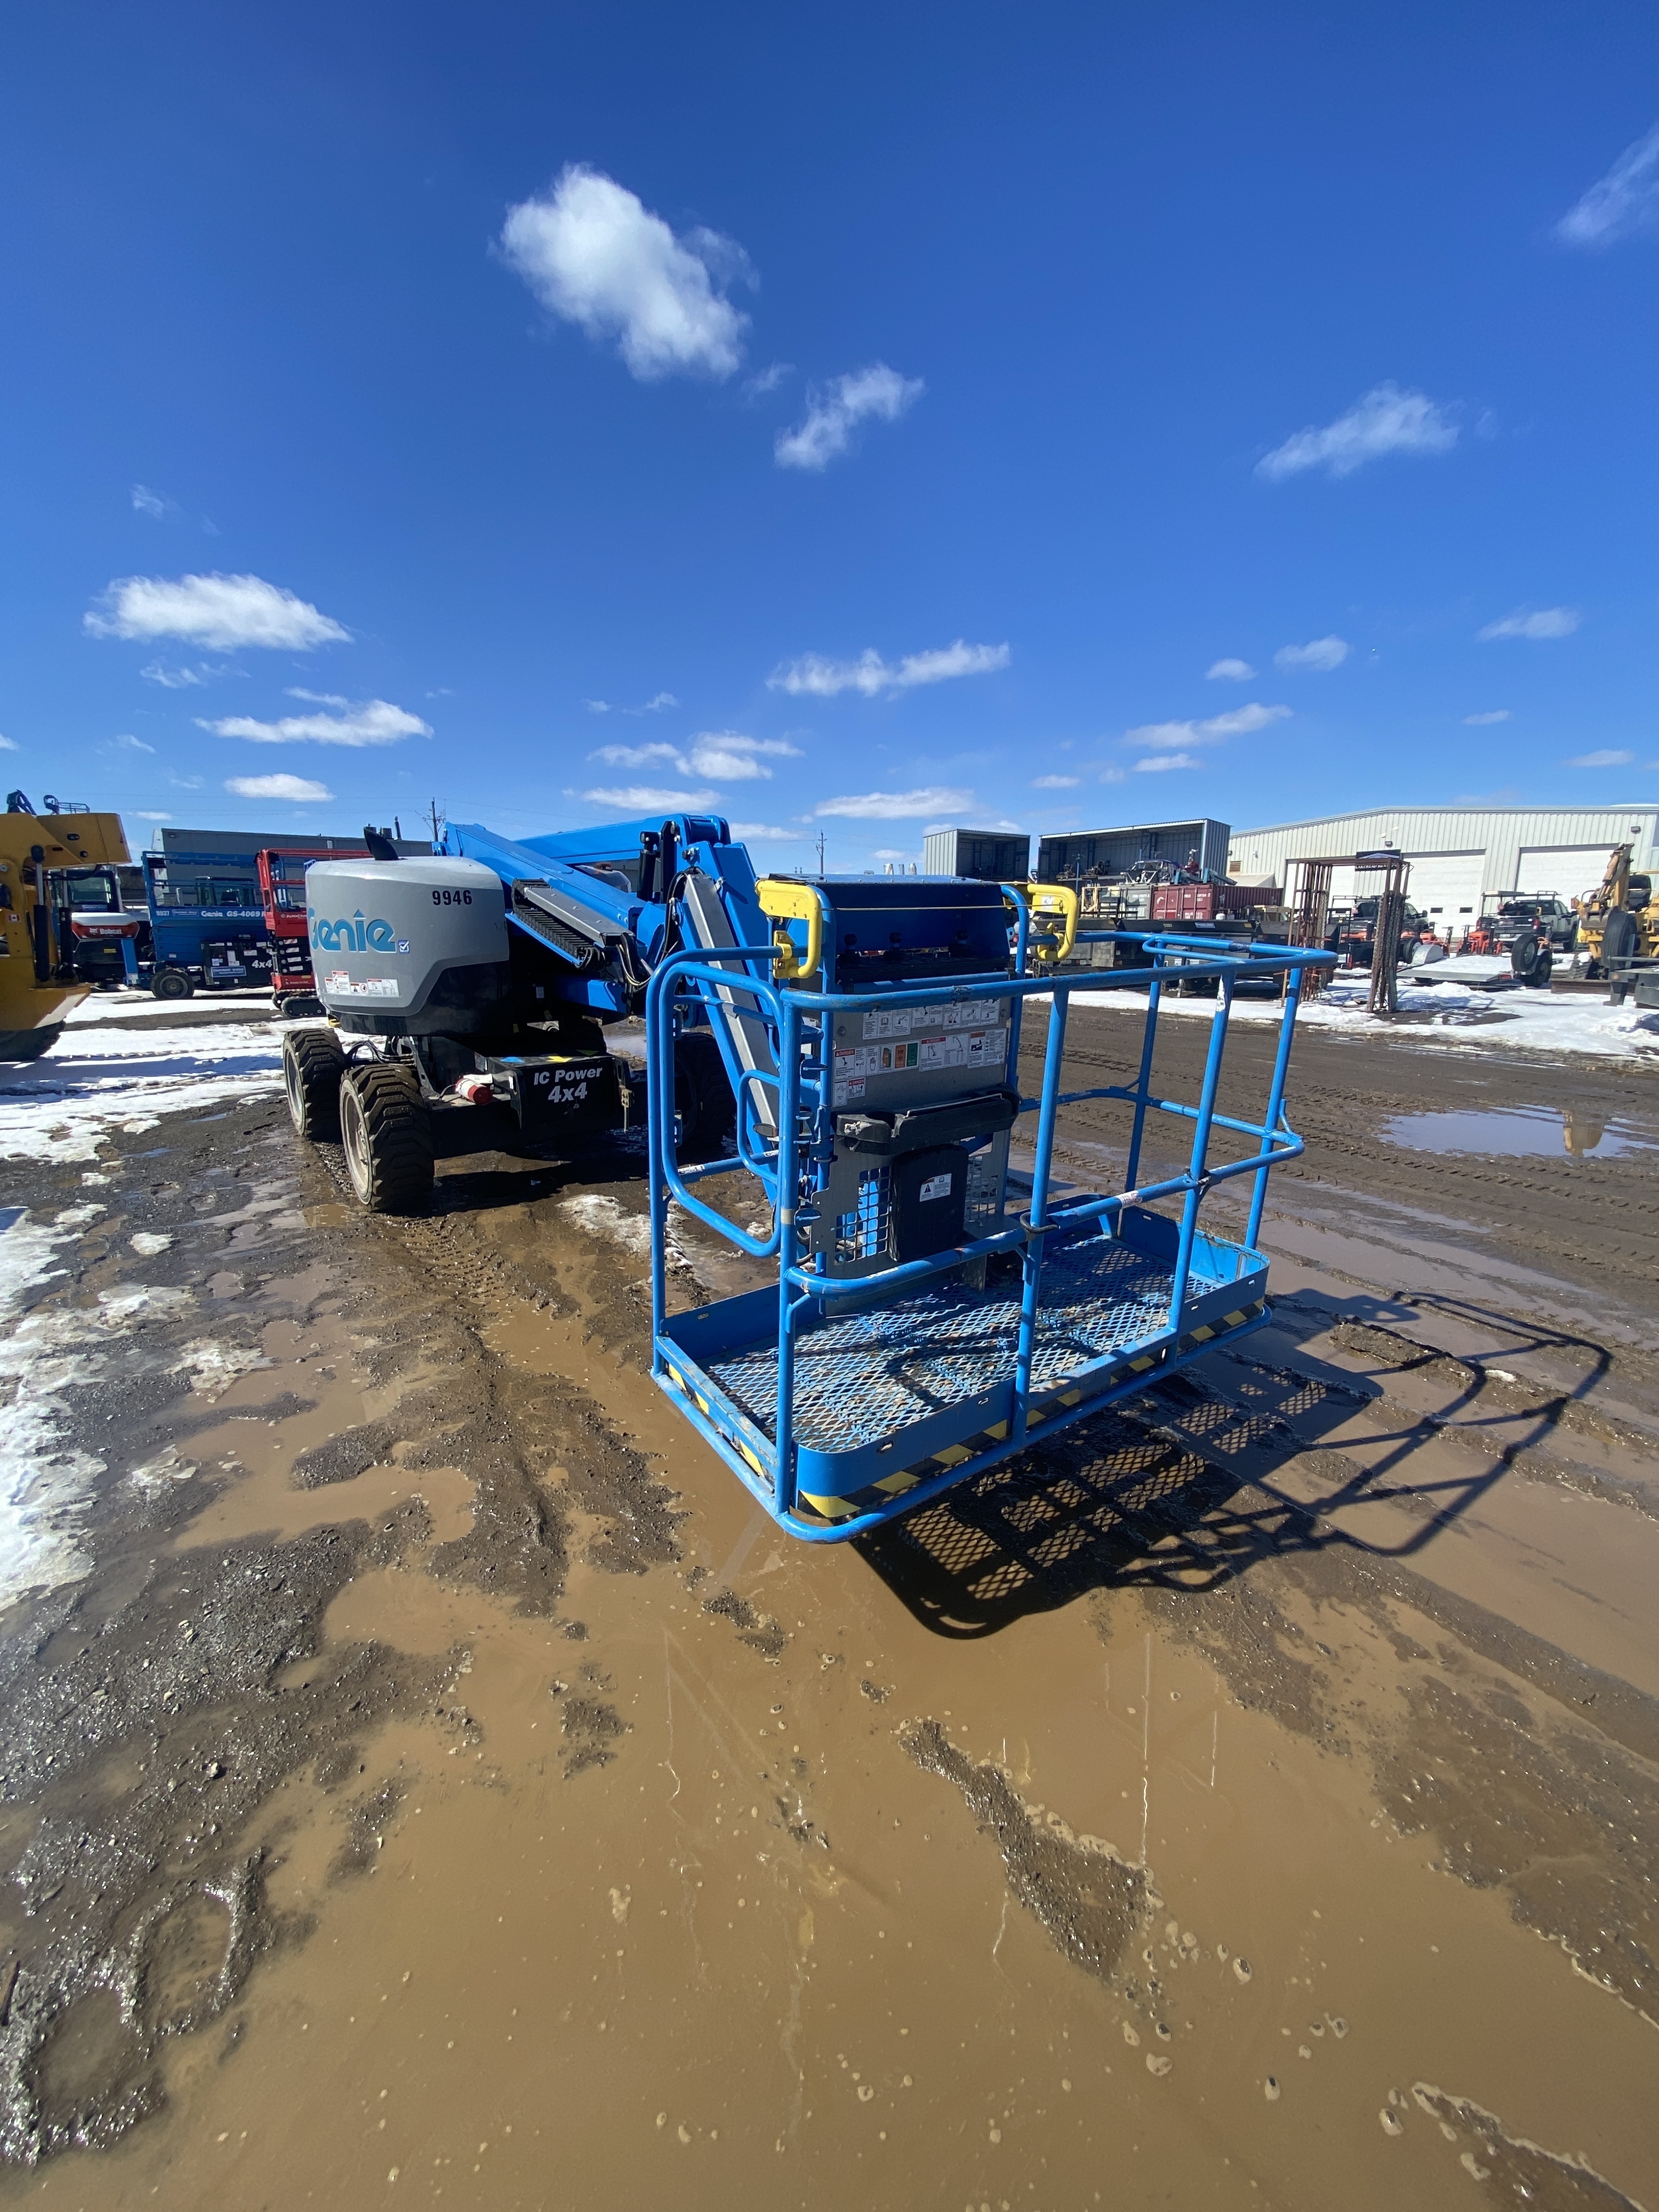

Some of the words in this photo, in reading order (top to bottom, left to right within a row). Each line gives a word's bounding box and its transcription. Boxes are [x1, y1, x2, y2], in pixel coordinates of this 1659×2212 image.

[432, 890, 472, 906] 9946
[252, 960, 273, 968] 4x4
[534, 1071, 550, 1086] IC
[555, 1067, 603, 1082] Power
[548, 1082, 588, 1103] 4x4
